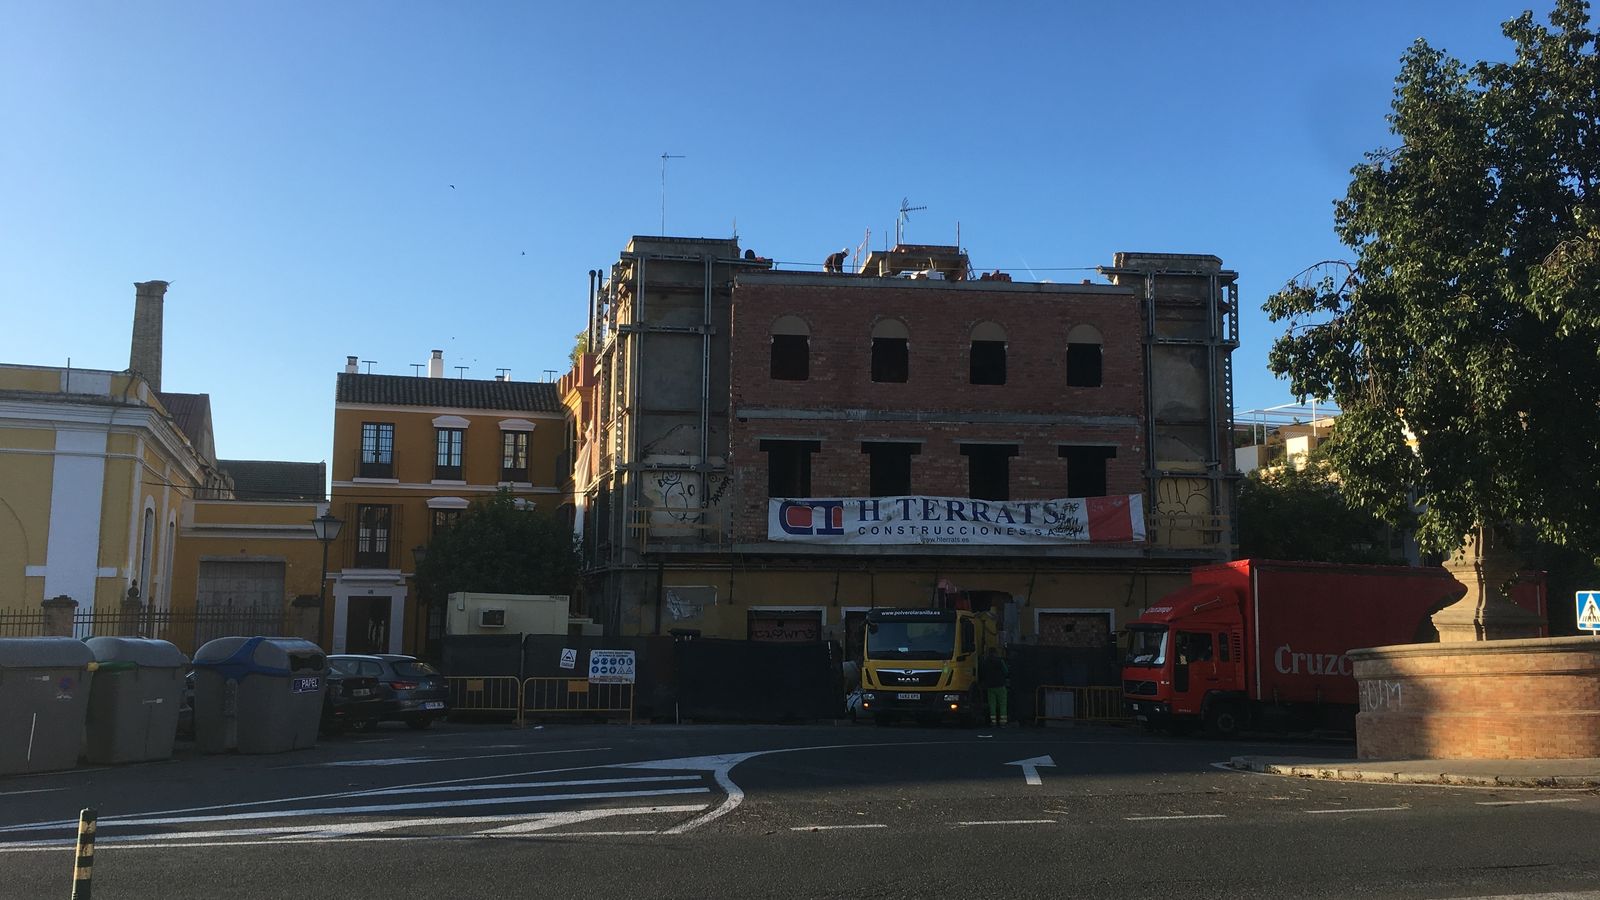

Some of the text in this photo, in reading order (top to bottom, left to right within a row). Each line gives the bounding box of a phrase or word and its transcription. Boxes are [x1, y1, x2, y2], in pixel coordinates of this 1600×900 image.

[857, 498, 882, 522] H
[895, 497, 1058, 525] TERRATS
[857, 525, 1028, 536] CONSTRUCCIONES
[920, 536, 970, 545] www.hterrats.es
[301, 677, 318, 689] PAPEL
